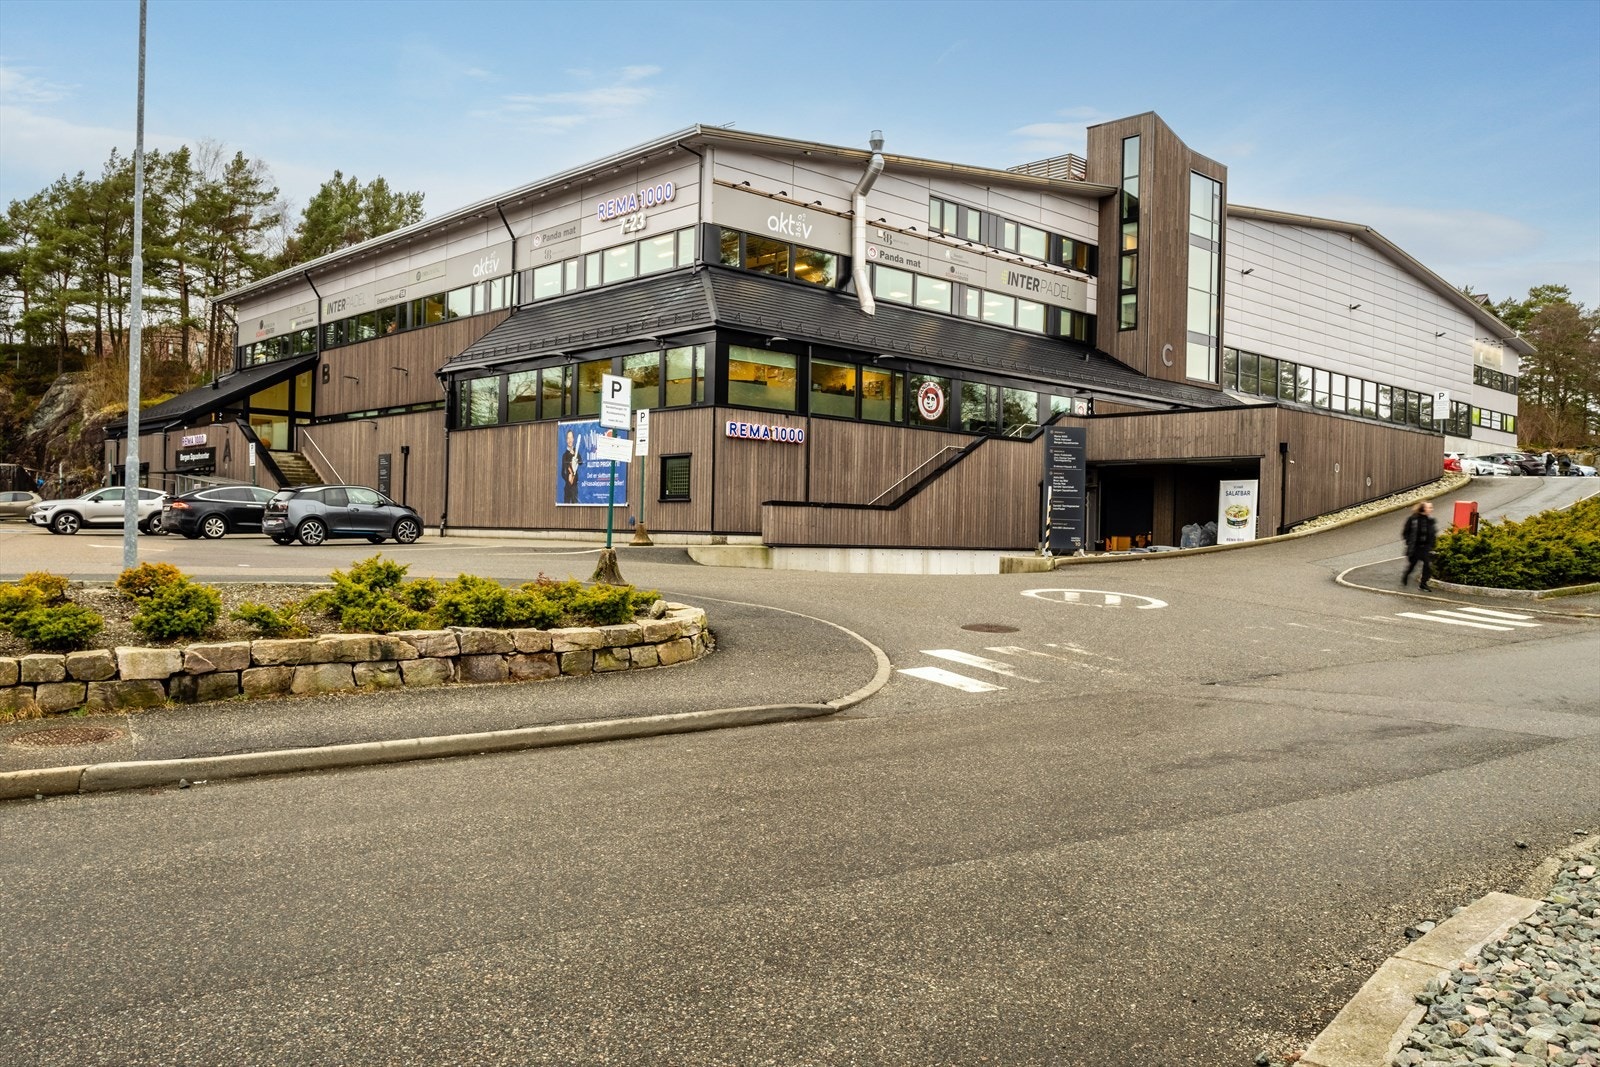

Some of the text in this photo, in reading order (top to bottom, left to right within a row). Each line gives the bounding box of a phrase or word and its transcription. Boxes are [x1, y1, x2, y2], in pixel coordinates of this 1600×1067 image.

[598, 181, 674, 221] REMA 1000
[542, 226, 576, 243] Panda mat
[619, 213, 647, 235] 7-23
[879, 250, 921, 268] Panda mat
[1162, 343, 1173, 367] C
[322, 363, 330, 384] B
[611, 380, 622, 399] P
[1438, 392, 1445, 400] P
[640, 412, 646, 422] P
[728, 422, 805, 444] REMA 1000
[223, 438, 233, 462] A
